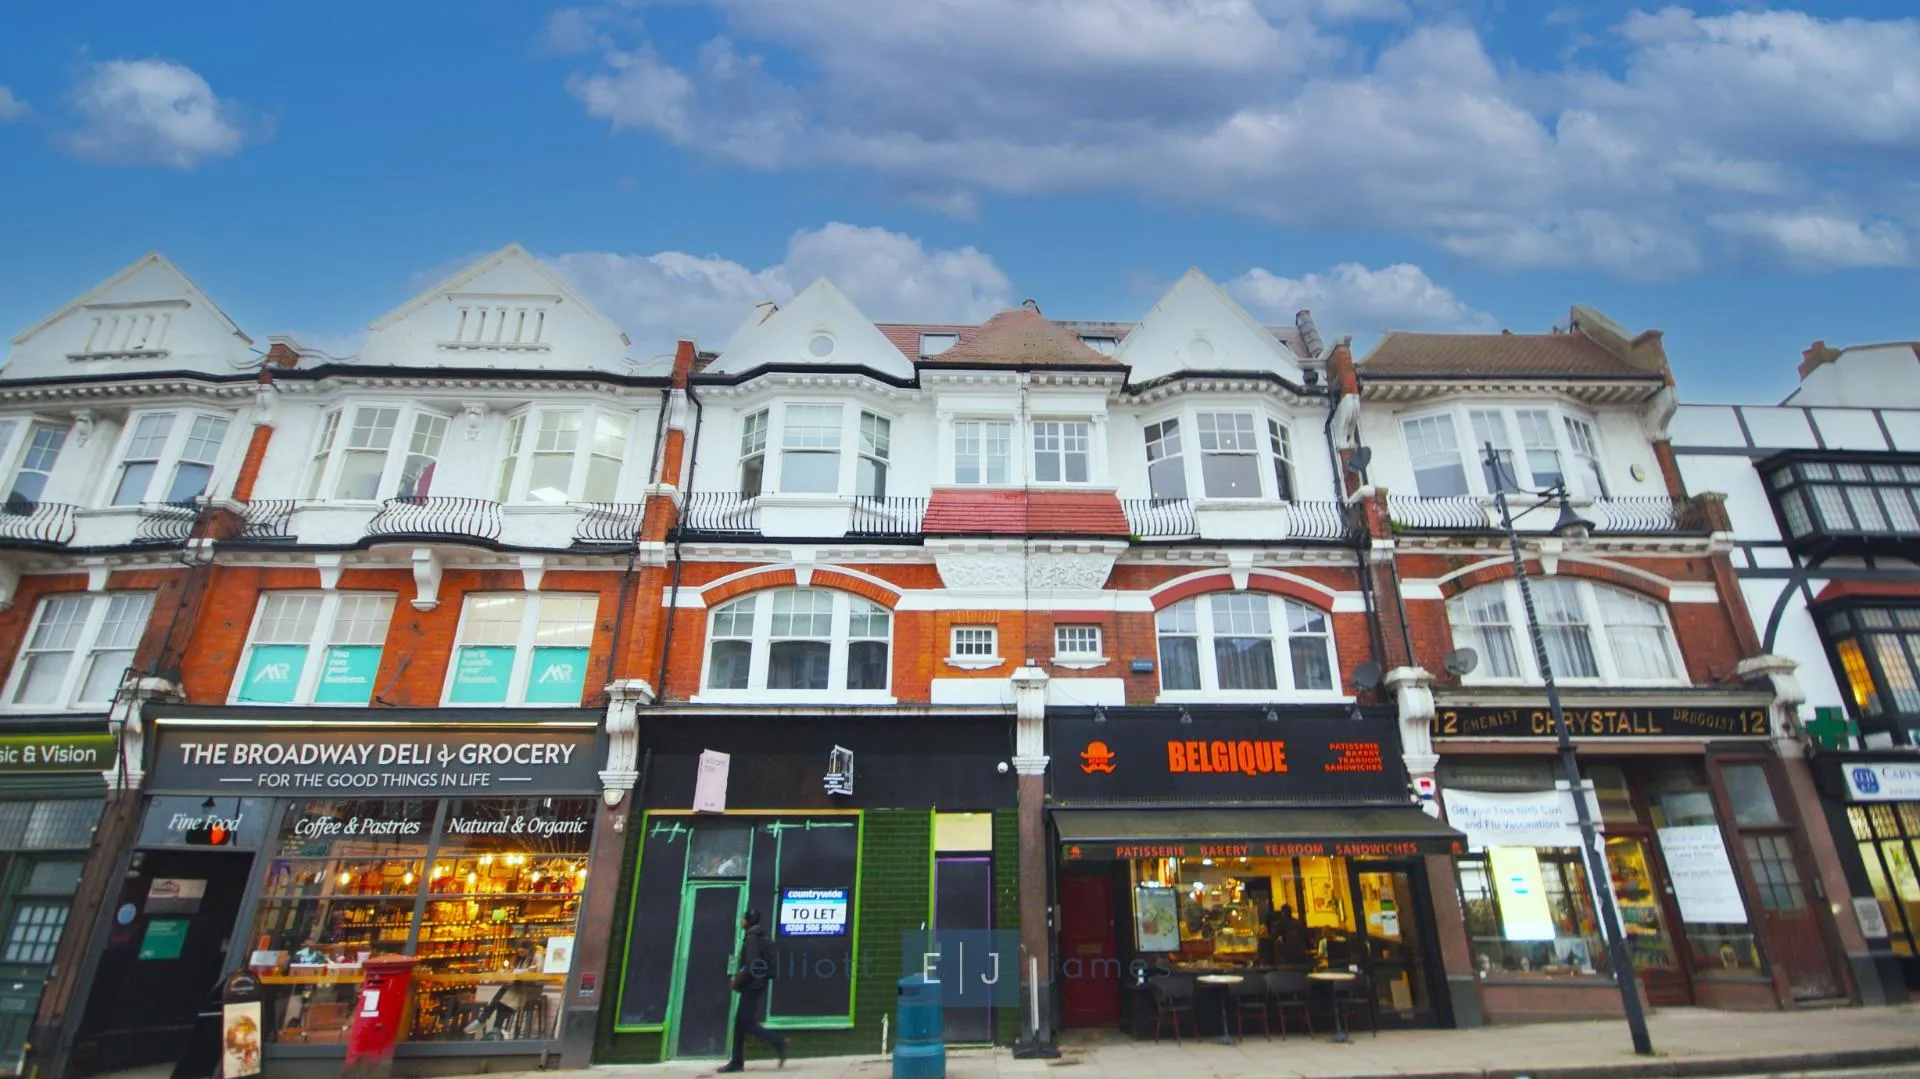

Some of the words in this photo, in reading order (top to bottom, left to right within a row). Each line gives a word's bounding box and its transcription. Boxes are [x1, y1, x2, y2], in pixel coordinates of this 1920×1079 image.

[1433, 711, 1457, 734] 12
[1739, 711, 1765, 734] 12
[23, 745, 36, 763] &
[41, 745, 97, 763] Vision
[181, 743, 228, 765] THE
[233, 743, 375, 765] BROADWAY
[378, 743, 432, 765] DELI
[437, 744, 456, 768] &
[459, 743, 576, 765] GROCERY
[1168, 741, 1288, 776] BELGIQUE
[258, 773, 289, 787] FOR
[294, 773, 324, 787] THE
[327, 773, 378, 787] GOOD
[381, 773, 437, 787] THINGS
[441, 773, 458, 787] IN
[460, 773, 490, 787] LIFE
[169, 813, 203, 832] Fine
[204, 813, 243, 832] Food
[294, 816, 342, 838] Coffee
[343, 817, 359, 834] &
[362, 817, 420, 834] Pastries
[448, 815, 510, 833] Natural
[511, 815, 524, 833] &
[527, 817, 587, 838] Organic
[1116, 846, 1185, 857] PATISSERIE
[1200, 845, 1249, 856] BAKERY
[1265, 843, 1324, 856] TEAROOM
[1335, 842, 1417, 855] SANDWICHES
[788, 890, 843, 899] countrywide
[792, 908, 809, 920] TO
[814, 908, 837, 920] LET
